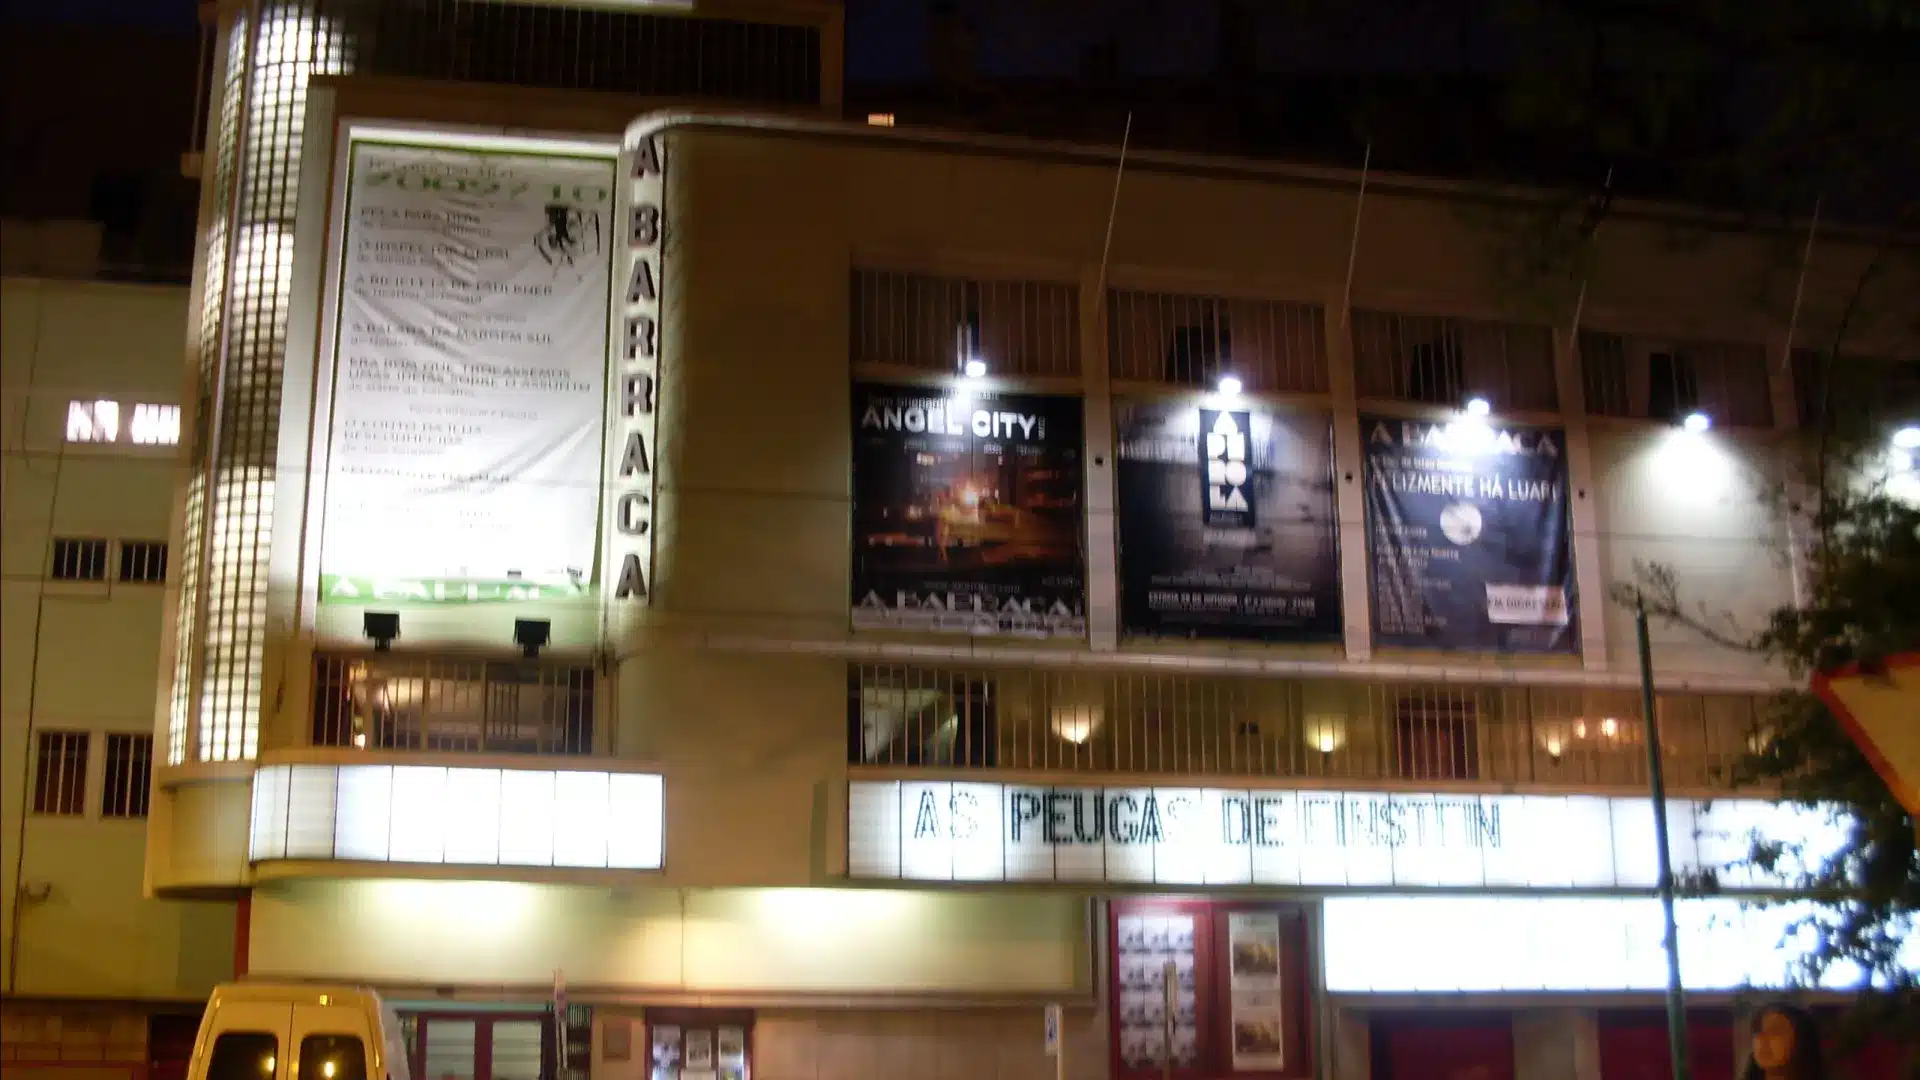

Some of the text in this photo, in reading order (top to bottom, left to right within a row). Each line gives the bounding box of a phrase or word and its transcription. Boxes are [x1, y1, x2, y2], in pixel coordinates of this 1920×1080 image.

[615, 135, 660, 601] A BARRACA
[862, 400, 964, 436] ANGEL
[972, 410, 1036, 440] CITY
[914, 790, 979, 839] AS
[1222, 796, 1284, 847] DE
